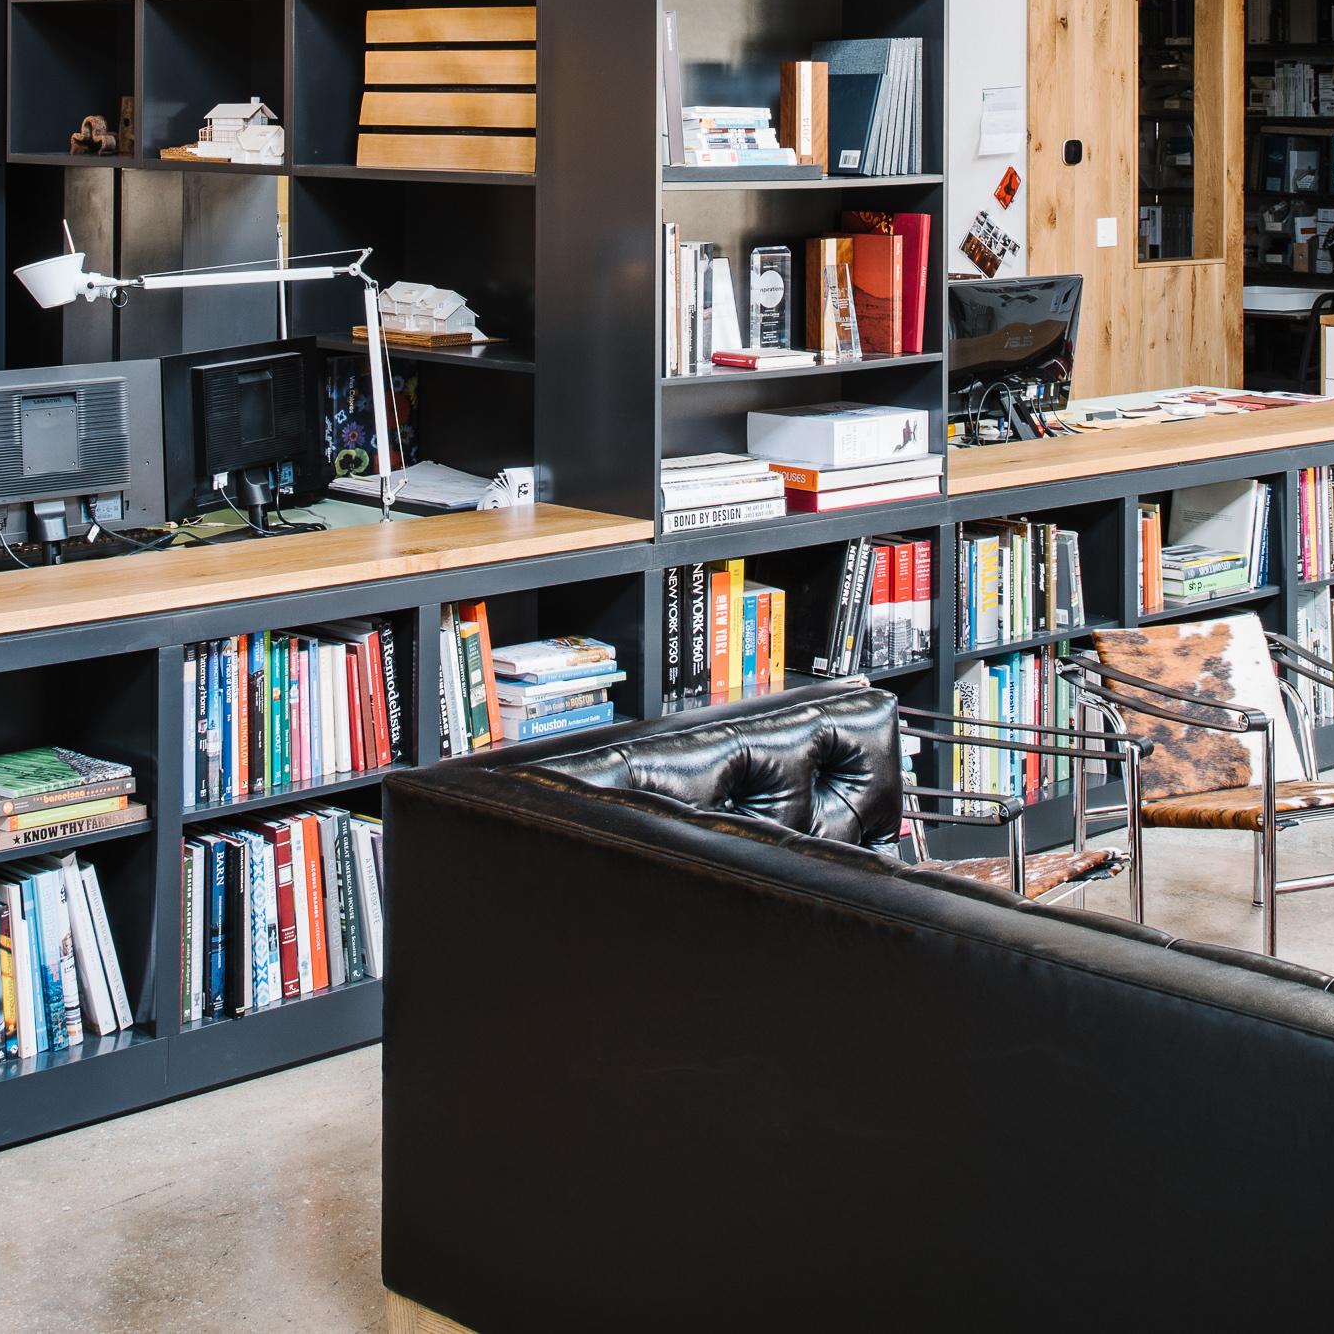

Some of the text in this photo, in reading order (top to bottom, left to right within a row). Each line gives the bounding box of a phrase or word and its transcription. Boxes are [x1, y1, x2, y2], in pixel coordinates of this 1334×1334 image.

[802, 117, 810, 142] 2014
[1005, 335, 1034, 349] ASUS
[674, 507, 741, 527] BOND BY DESIGN
[841, 545, 857, 606] NEW YORK
[854, 544, 869, 603] SHANGHAI
[980, 542, 998, 612] S,M,L,XL
[669, 568, 677, 663] NEW YORK 1930
[693, 563, 703, 662] NEW YORK 1960
[715, 603, 727, 656] NEW YORK
[198, 653, 207, 685] Patterns
[559, 670, 582, 678] LANGUAGE
[383, 642, 402, 744] Remodelista
[570, 694, 594, 707] BOSTON
[532, 717, 567, 734] Houston
[568, 717, 590, 725] Architectural
[23, 826, 58, 844] KNOW
[60, 822, 85, 836] THY
[86, 812, 126, 830] FARMER
[216, 851, 225, 886] BARN
[366, 865, 376, 892] FRAME
[328, 859, 342, 951] AXEL VERVOORDT
[370, 893, 378, 907] FOR
[372, 908, 380, 925] LIFE
[41, 884, 57, 955] SPACECRAFT
[87, 873, 126, 1011] INSPIRED INTERIORS SUZANNE KASLER
